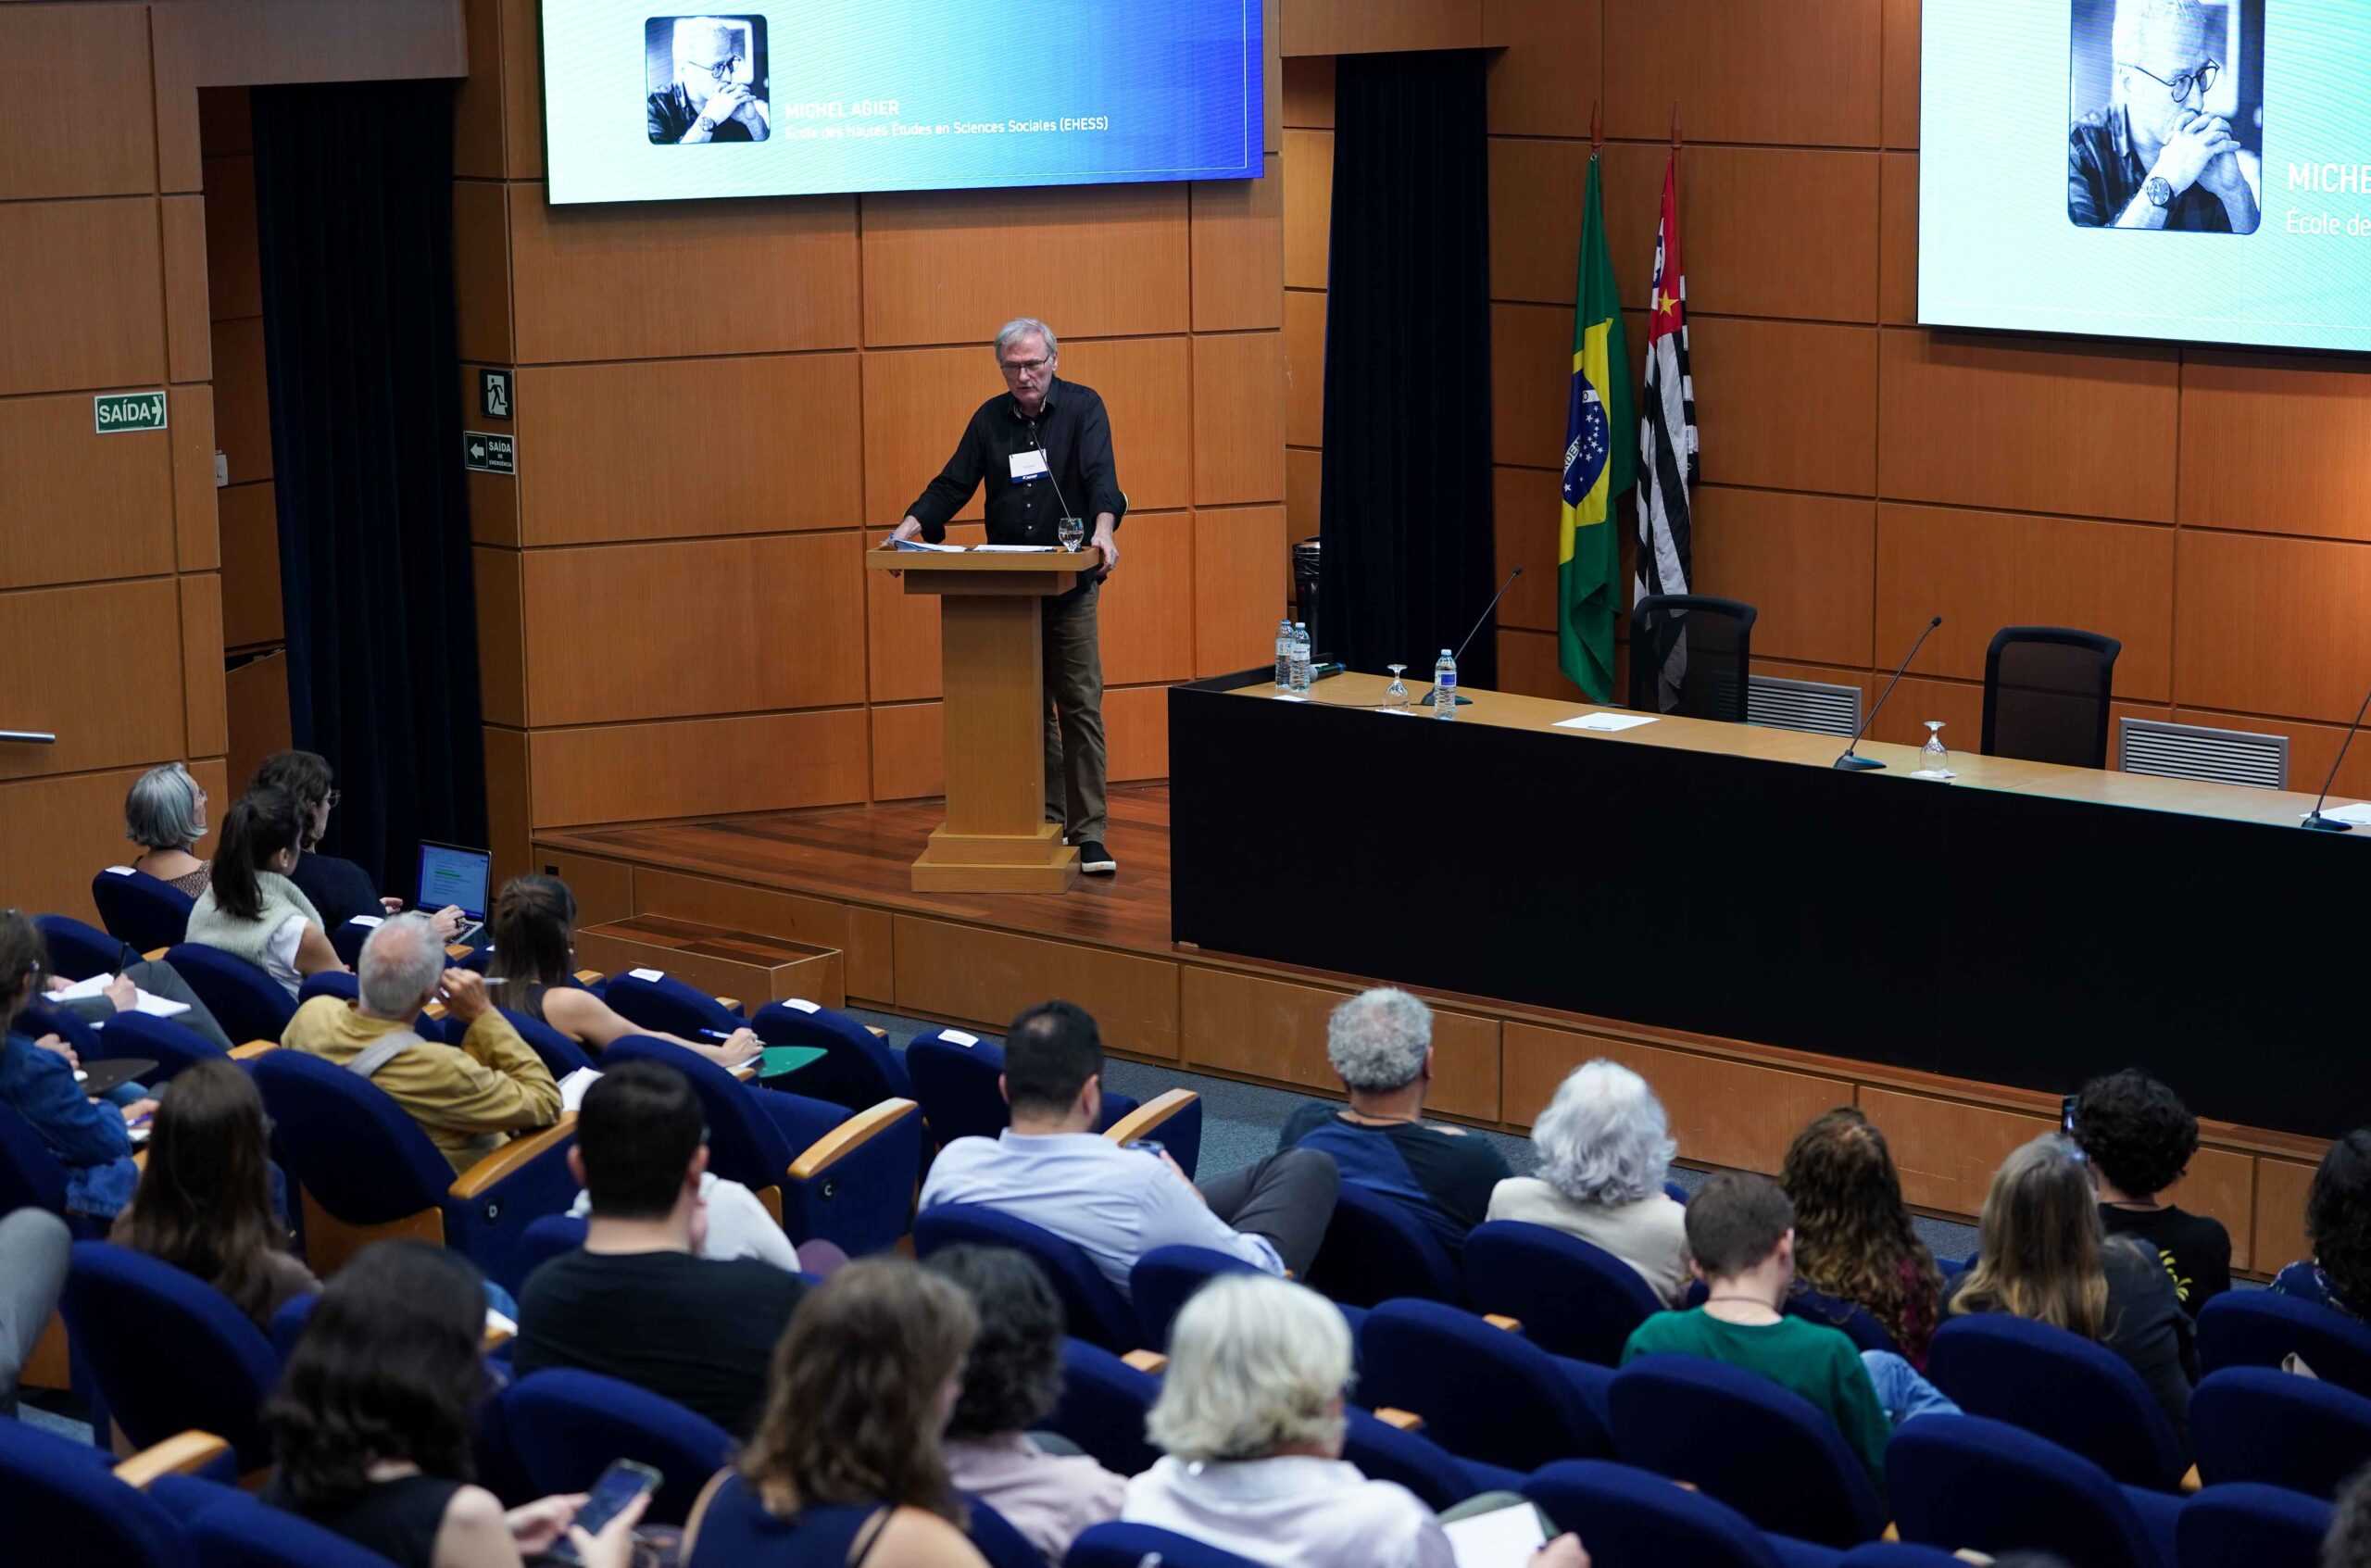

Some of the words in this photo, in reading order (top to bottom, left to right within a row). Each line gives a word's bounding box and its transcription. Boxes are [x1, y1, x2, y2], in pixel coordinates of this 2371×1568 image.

[785, 101, 845, 119] MICHEL
[852, 99, 899, 118] AGIER
[935, 124, 951, 135] en
[953, 120, 1005, 134] Sciences
[1009, 119, 1057, 133] Sociales
[1060, 115, 1110, 133] (EHESS)
[2289, 162, 2371, 194] MICHE
[2287, 207, 2340, 235] École
[99, 398, 152, 424] SAÍDA
[488, 439, 512, 454] SAÍDA
[824, 1184, 834, 1197] C
[489, 1204, 498, 1219] D
